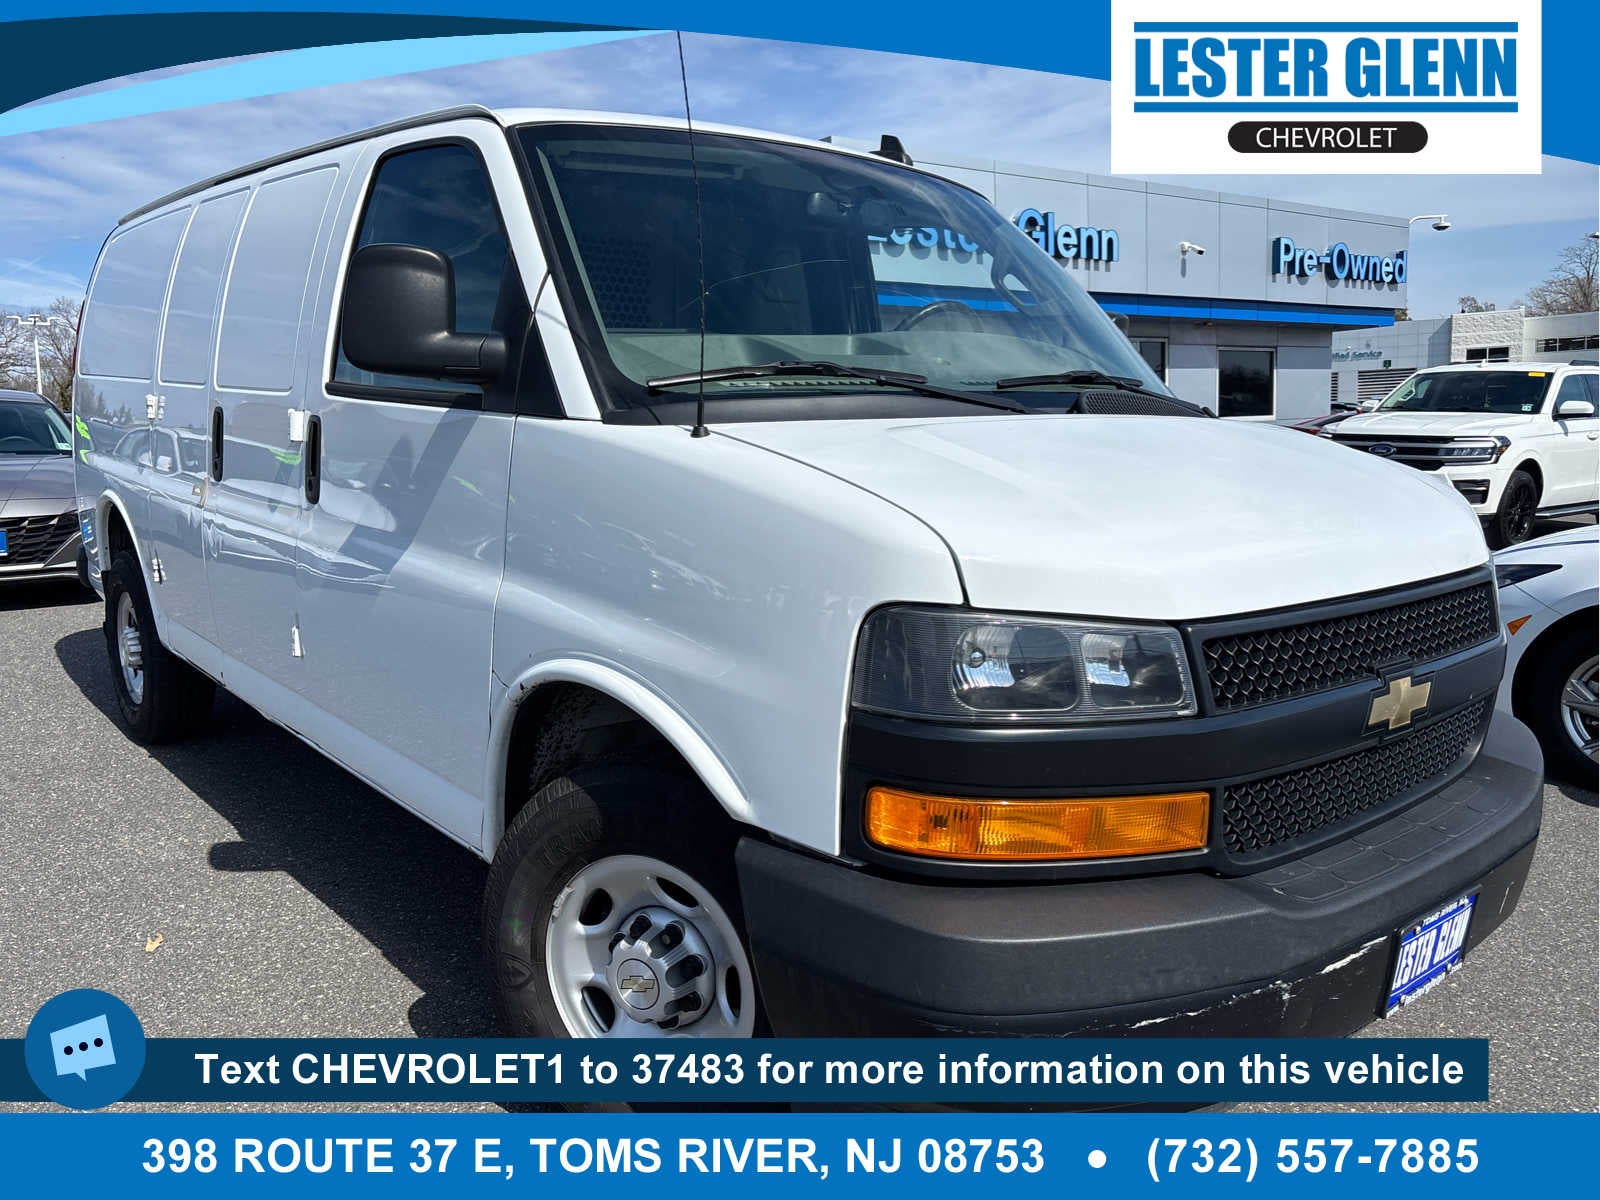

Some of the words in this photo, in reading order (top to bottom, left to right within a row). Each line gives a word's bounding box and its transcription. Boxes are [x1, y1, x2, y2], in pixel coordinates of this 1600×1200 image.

[1014, 207, 1120, 263] Glenn
[1272, 236, 1408, 284] Pre-Owned
[1391, 927, 1438, 991] LESTER
[1432, 905, 1473, 965] GLENN
